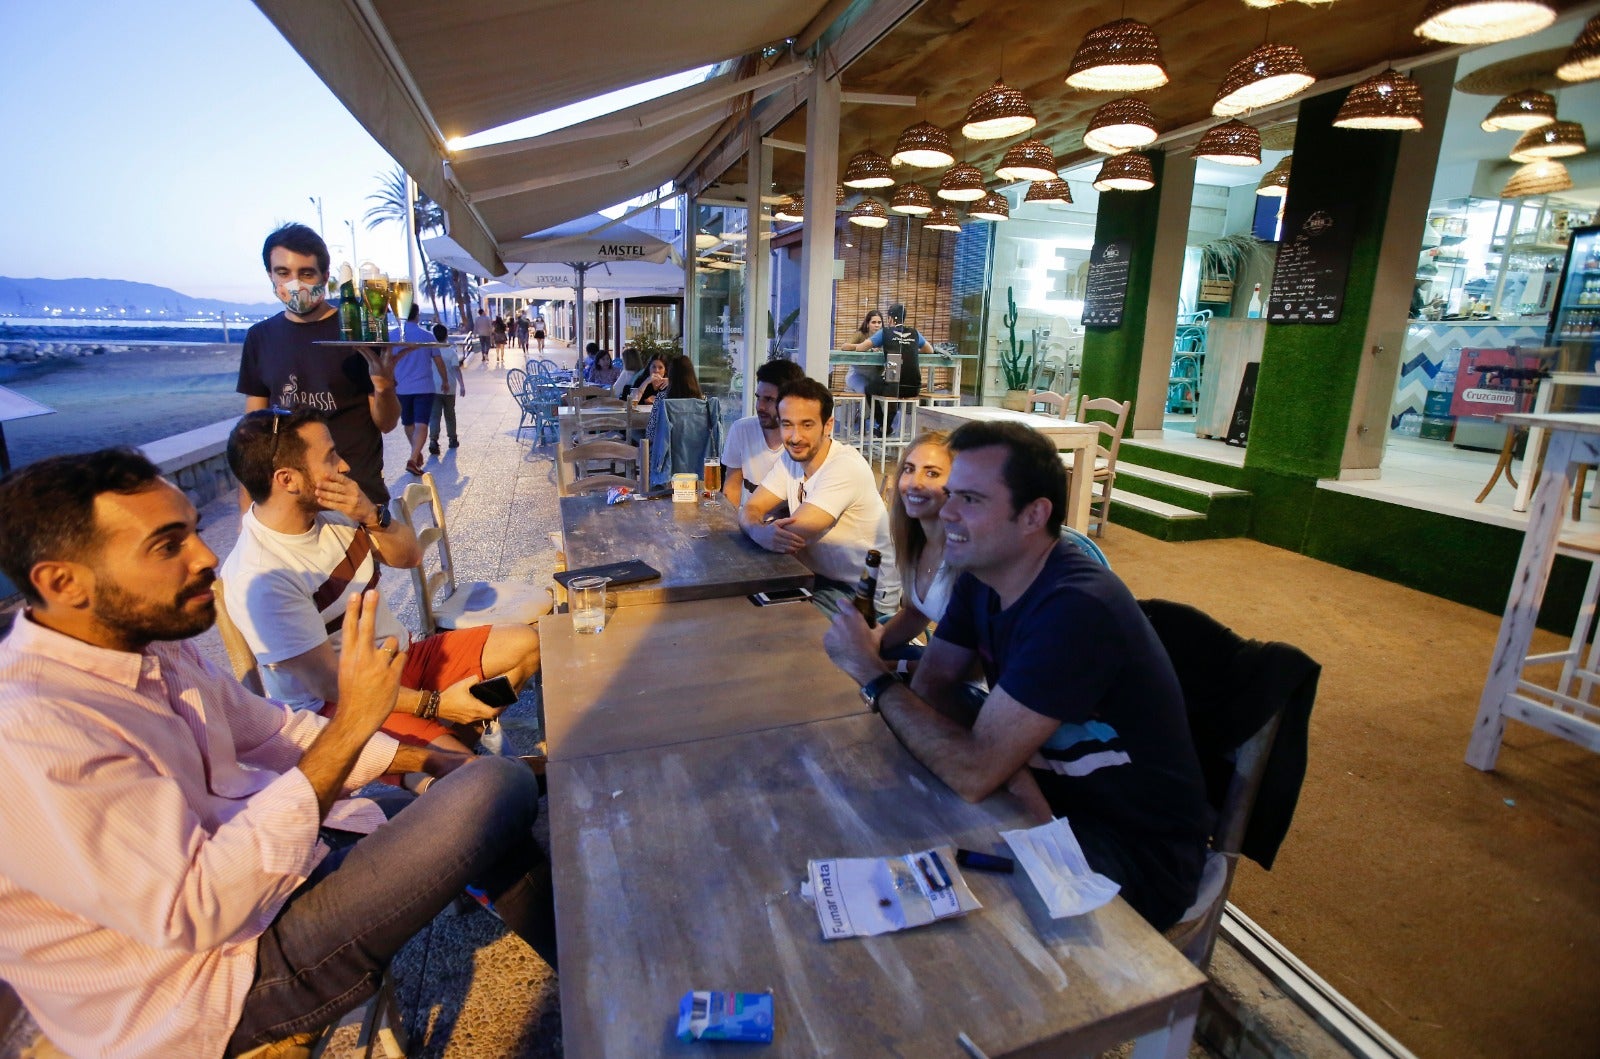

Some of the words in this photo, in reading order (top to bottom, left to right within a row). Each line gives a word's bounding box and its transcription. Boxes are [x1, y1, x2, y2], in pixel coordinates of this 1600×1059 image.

[597, 244, 646, 256] AMSTEL
[820, 863, 834, 897] mata
[826, 898, 846, 934] Fumar
